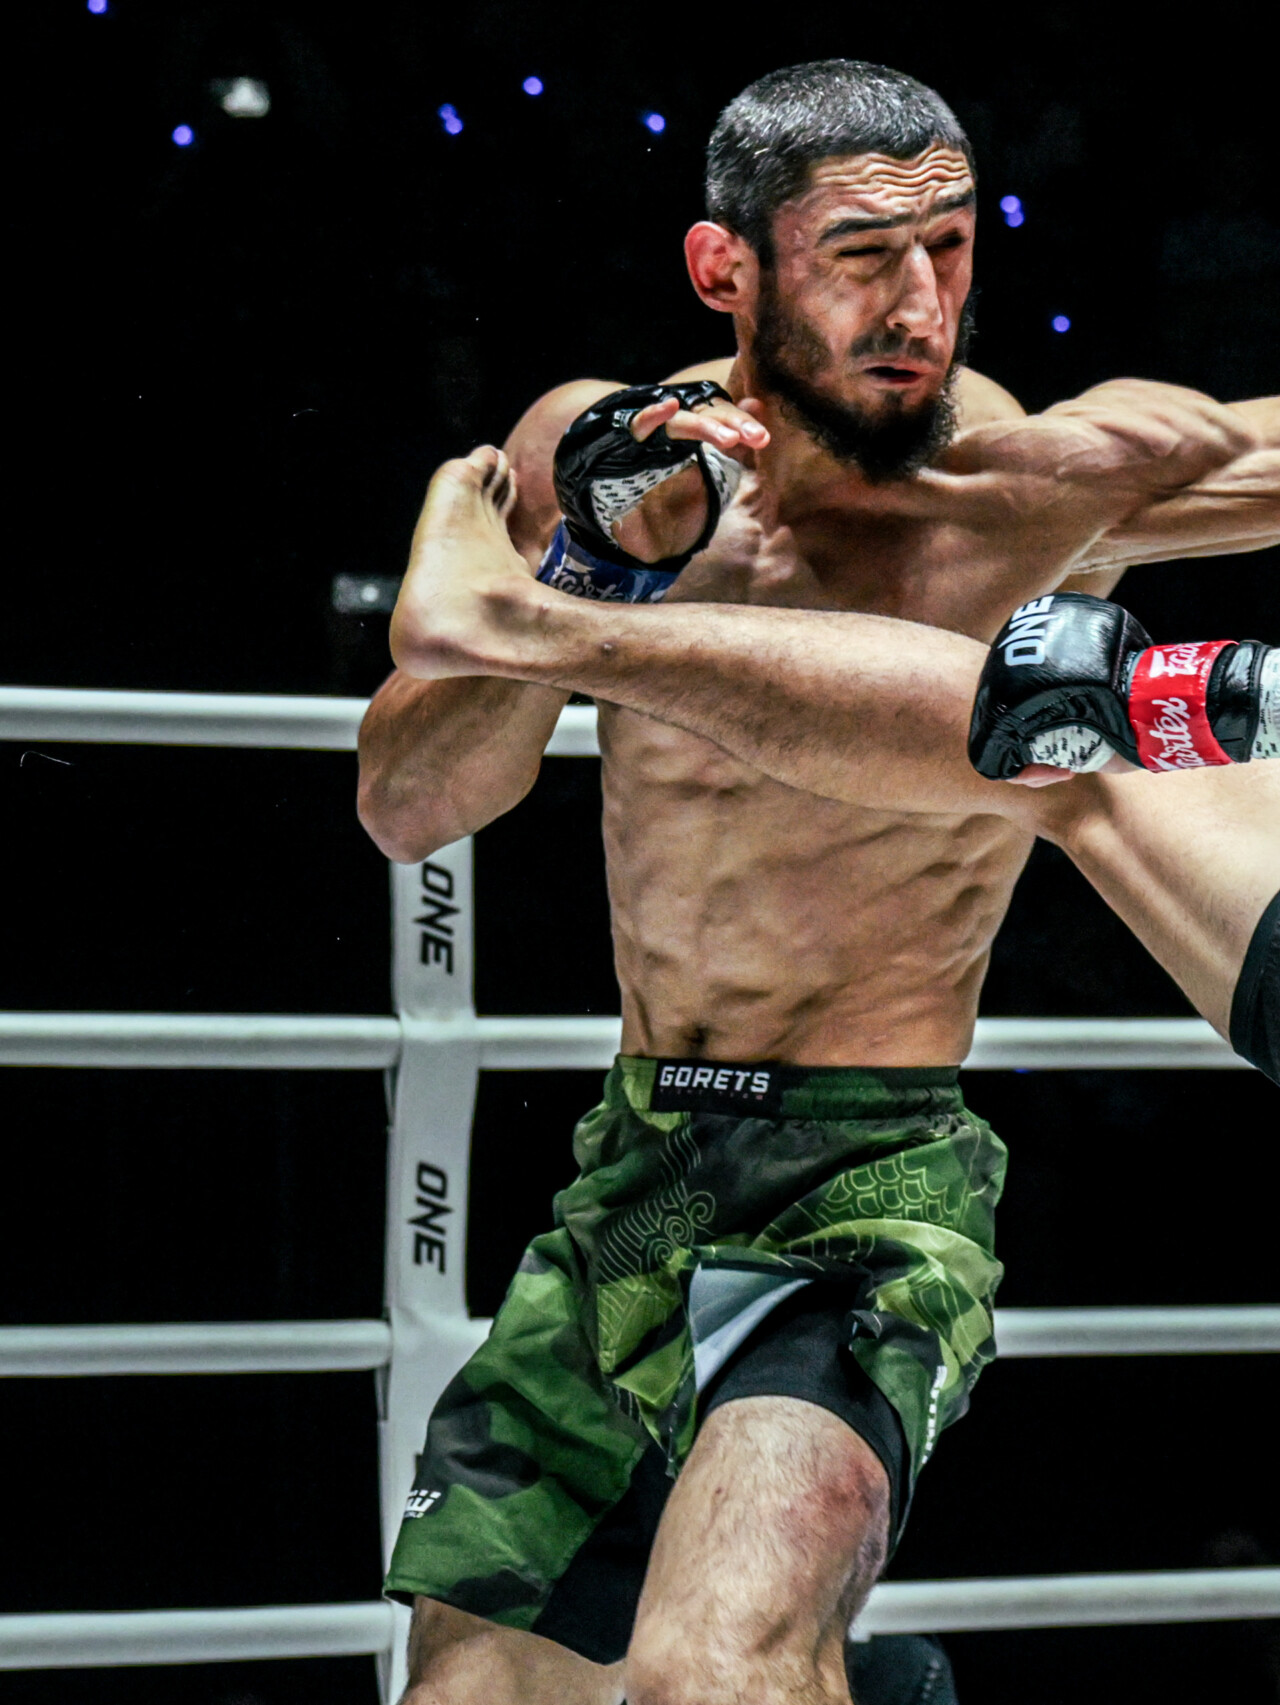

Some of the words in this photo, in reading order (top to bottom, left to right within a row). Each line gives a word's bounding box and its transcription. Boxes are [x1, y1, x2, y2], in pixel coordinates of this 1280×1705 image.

[998, 595, 1057, 667] ONE
[413, 862, 461, 975] ONE
[659, 1066, 771, 1094] GORETS
[407, 1161, 454, 1275] ONE
